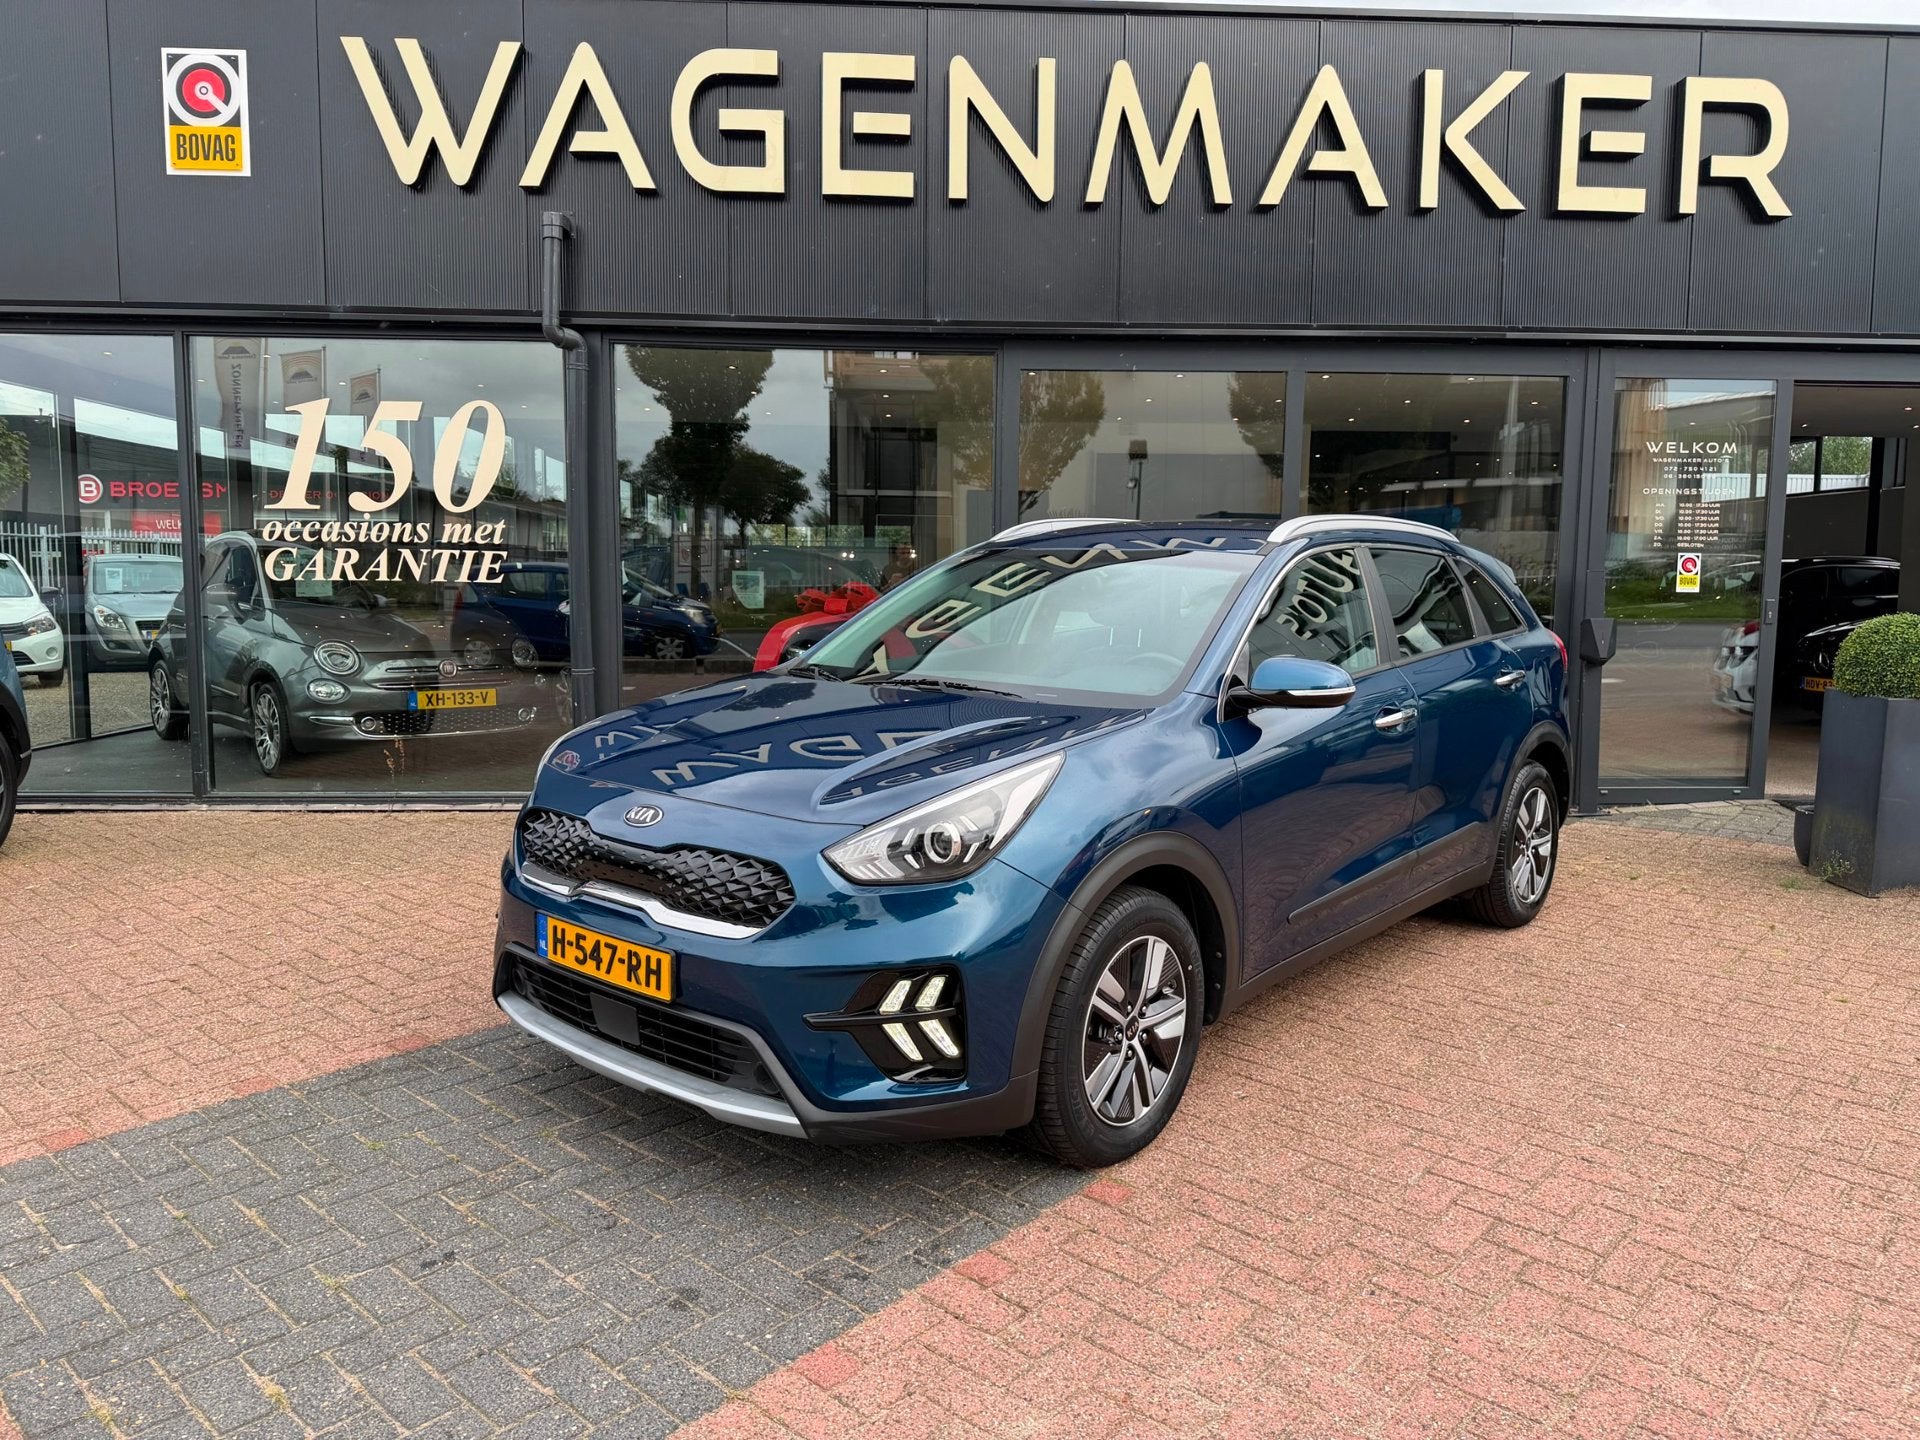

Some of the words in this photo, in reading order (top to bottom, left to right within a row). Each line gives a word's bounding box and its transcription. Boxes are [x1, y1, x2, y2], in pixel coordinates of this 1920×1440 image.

[341, 36, 1792, 219] WAGENMAKER
[176, 133, 236, 162] BOVAG
[263, 398, 506, 513] 150
[1645, 441, 1738, 454] WELKOM
[1643, 487, 1736, 495] OPENINGSTIJDEN
[262, 512, 432, 543] occasions
[442, 519, 506, 544] met
[264, 547, 508, 584] GARANTIE
[1680, 576, 1697, 586] BOVAG
[425, 691, 489, 706] XH-133-V
[626, 806, 655, 822] KIA
[539, 939, 548, 950] NL
[552, 924, 662, 991] H-547-RH
[1126, 1021, 1139, 1038] KIA
